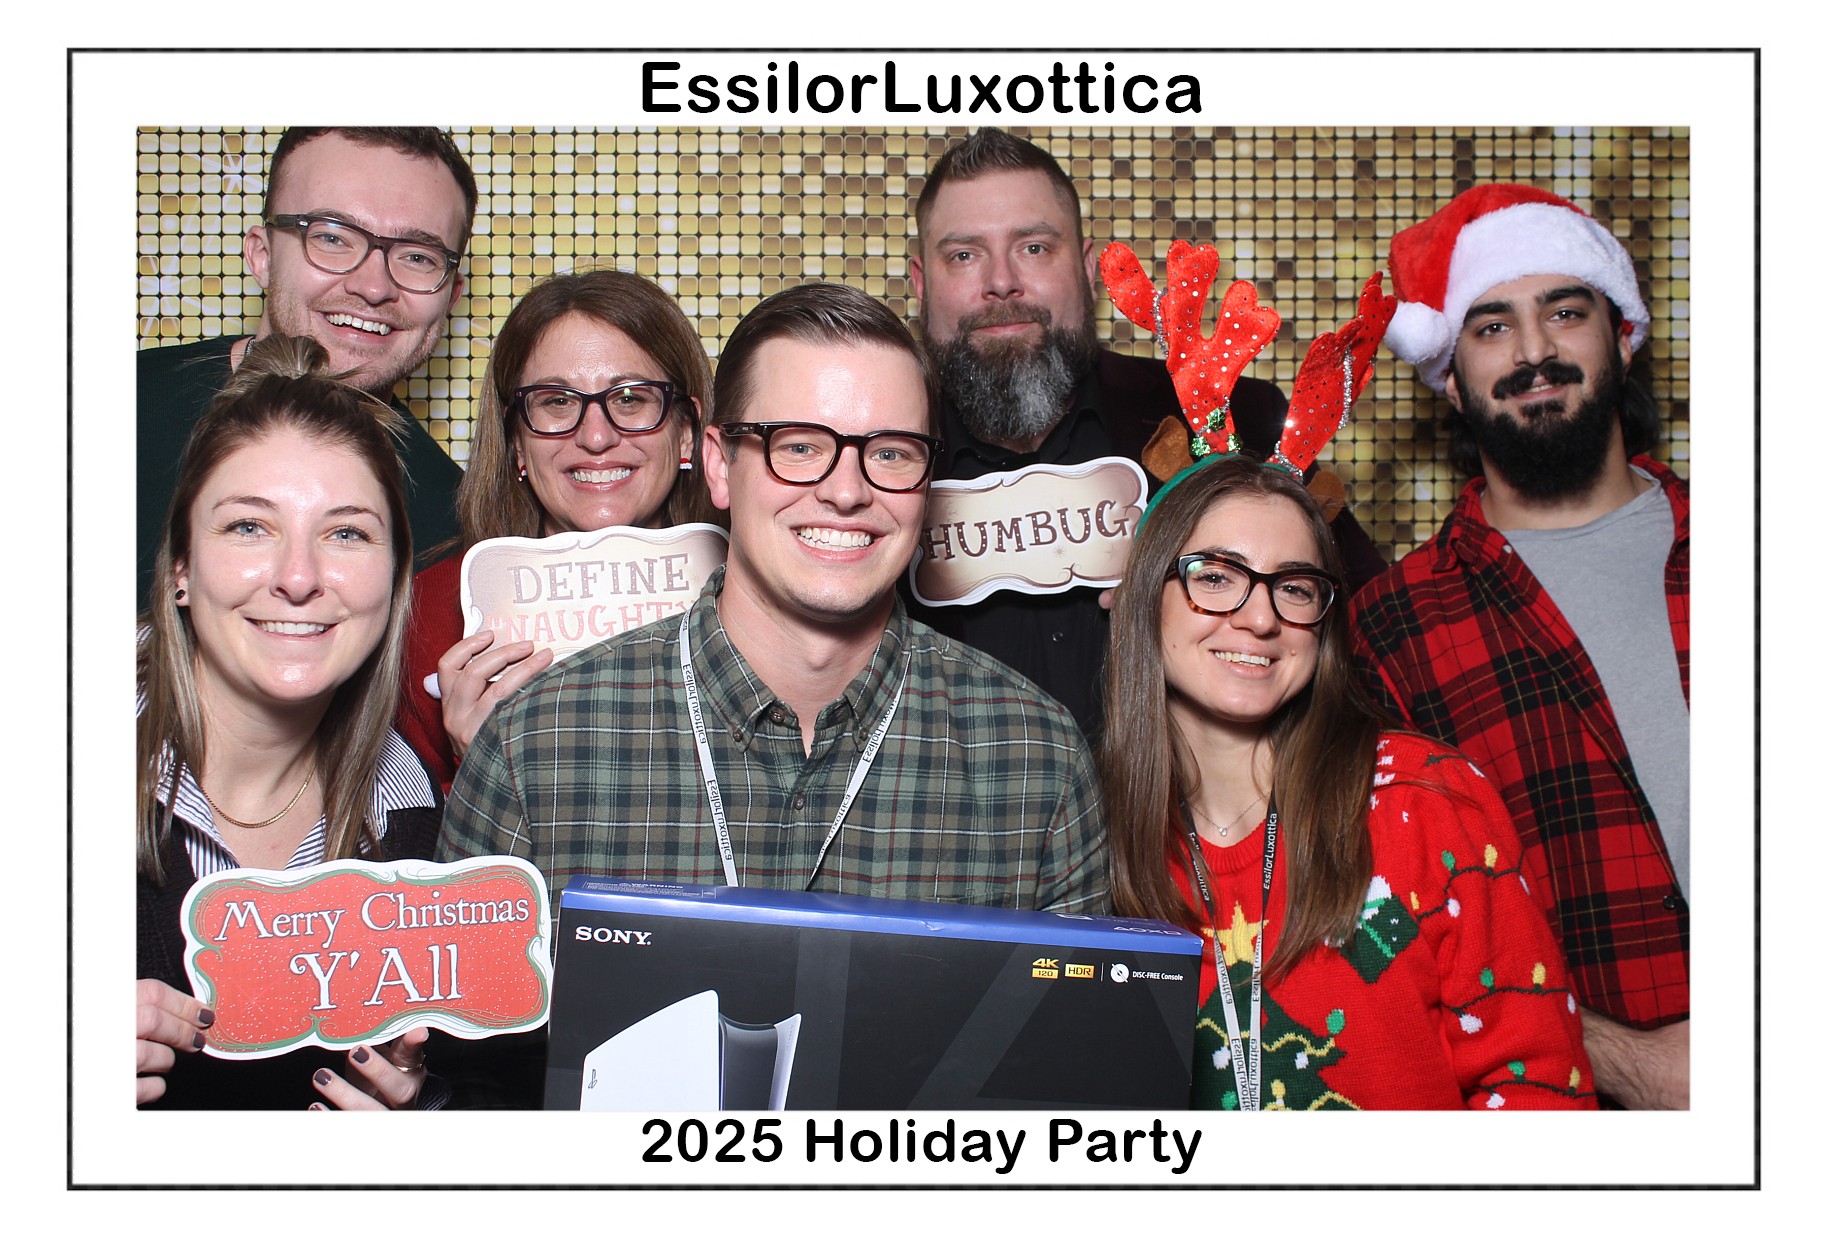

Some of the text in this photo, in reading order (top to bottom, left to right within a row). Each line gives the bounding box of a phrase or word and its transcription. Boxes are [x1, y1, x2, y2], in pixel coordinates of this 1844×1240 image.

[922, 500, 1129, 561] HUMBUG
[507, 553, 690, 604] DEFINE
[1263, 813, 1278, 890] EssilorLuxottica
[214, 890, 530, 949] Merry Christmas
[575, 926, 652, 945] SONY
[289, 943, 463, 1010] Y'All
[1032, 958, 1060, 969] 4K
[1068, 967, 1091, 976] HDR
[1132, 971, 1184, 981] DISC-FREE Console
